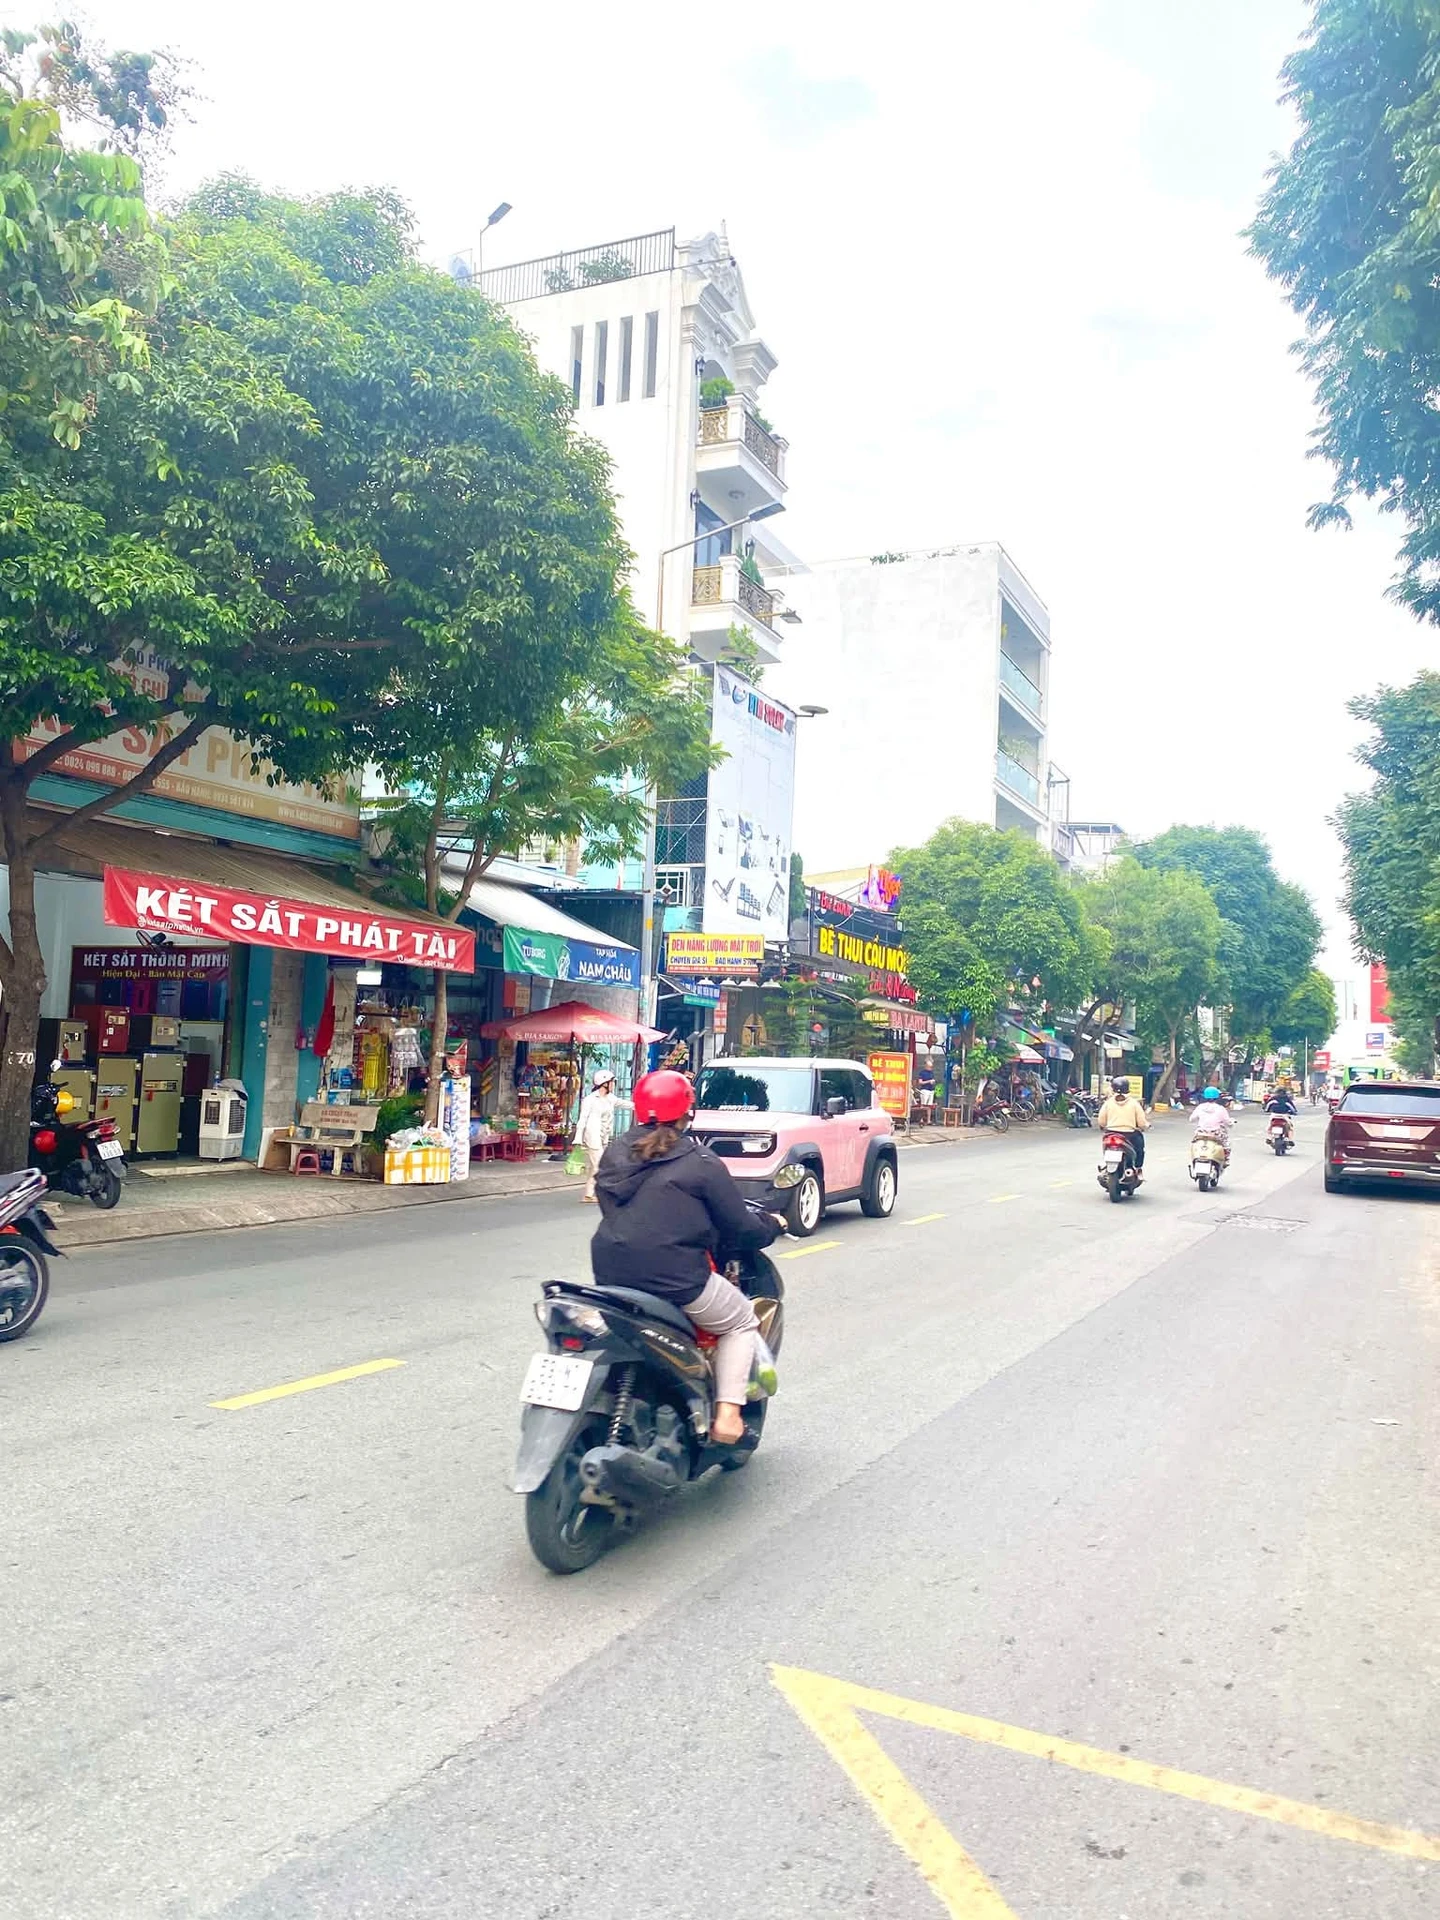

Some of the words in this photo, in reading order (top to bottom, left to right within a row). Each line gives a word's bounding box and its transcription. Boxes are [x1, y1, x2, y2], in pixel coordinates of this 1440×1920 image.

[136, 887, 218, 924] KÉT
[230, 899, 305, 938] SẮT
[315, 917, 403, 952] PHÁT
[411, 932, 457, 959] TÀI
[111, 950, 137, 967] SẮT
[141, 952, 186, 967] THÔNG
[191, 953, 230, 967] MINH
[521, 945, 546, 960] TUBORG
[838, 933, 863, 963] THUI
[579, 961, 603, 978] NAM
[604, 963, 632, 982] CHÂU
